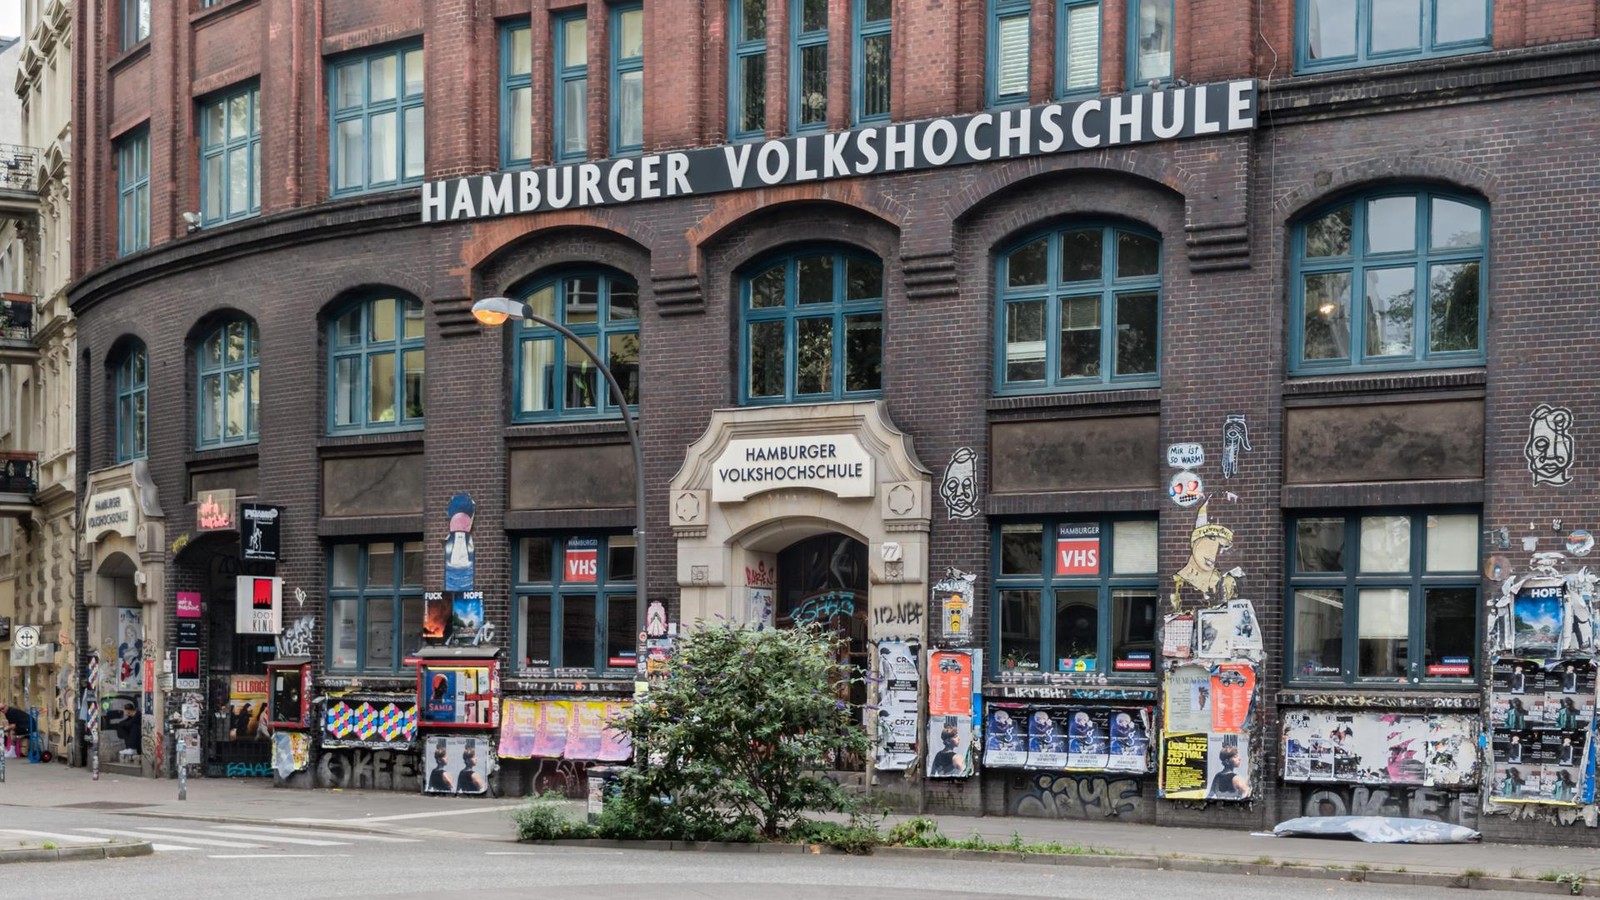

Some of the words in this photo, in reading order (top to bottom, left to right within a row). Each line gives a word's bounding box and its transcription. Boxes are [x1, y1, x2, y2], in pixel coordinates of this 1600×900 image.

[421, 152, 693, 222] HAMBURGER
[726, 80, 1254, 188] VOLKSHOCHSCHULE
[745, 443, 837, 462] HAMBURGER
[1181, 455, 1203, 464] WARM!
[719, 463, 863, 482] VOLKSHOCHSCHULE
[1060, 526, 1100, 534] HAMBURGER
[883, 545, 899, 559] 77
[1061, 549, 1097, 567] VHS
[569, 559, 597, 575] VHS
[424, 592, 443, 600] FUCK
[463, 591, 484, 599] HOPE
[1531, 588, 1563, 598] HOPE
[253, 619, 273, 632] KINO
[429, 703, 454, 712] SAMIA
[895, 718, 915, 726] CR7Z
[1167, 750, 1204, 759] FESTIVAL
[1166, 757, 1187, 765] 2024
